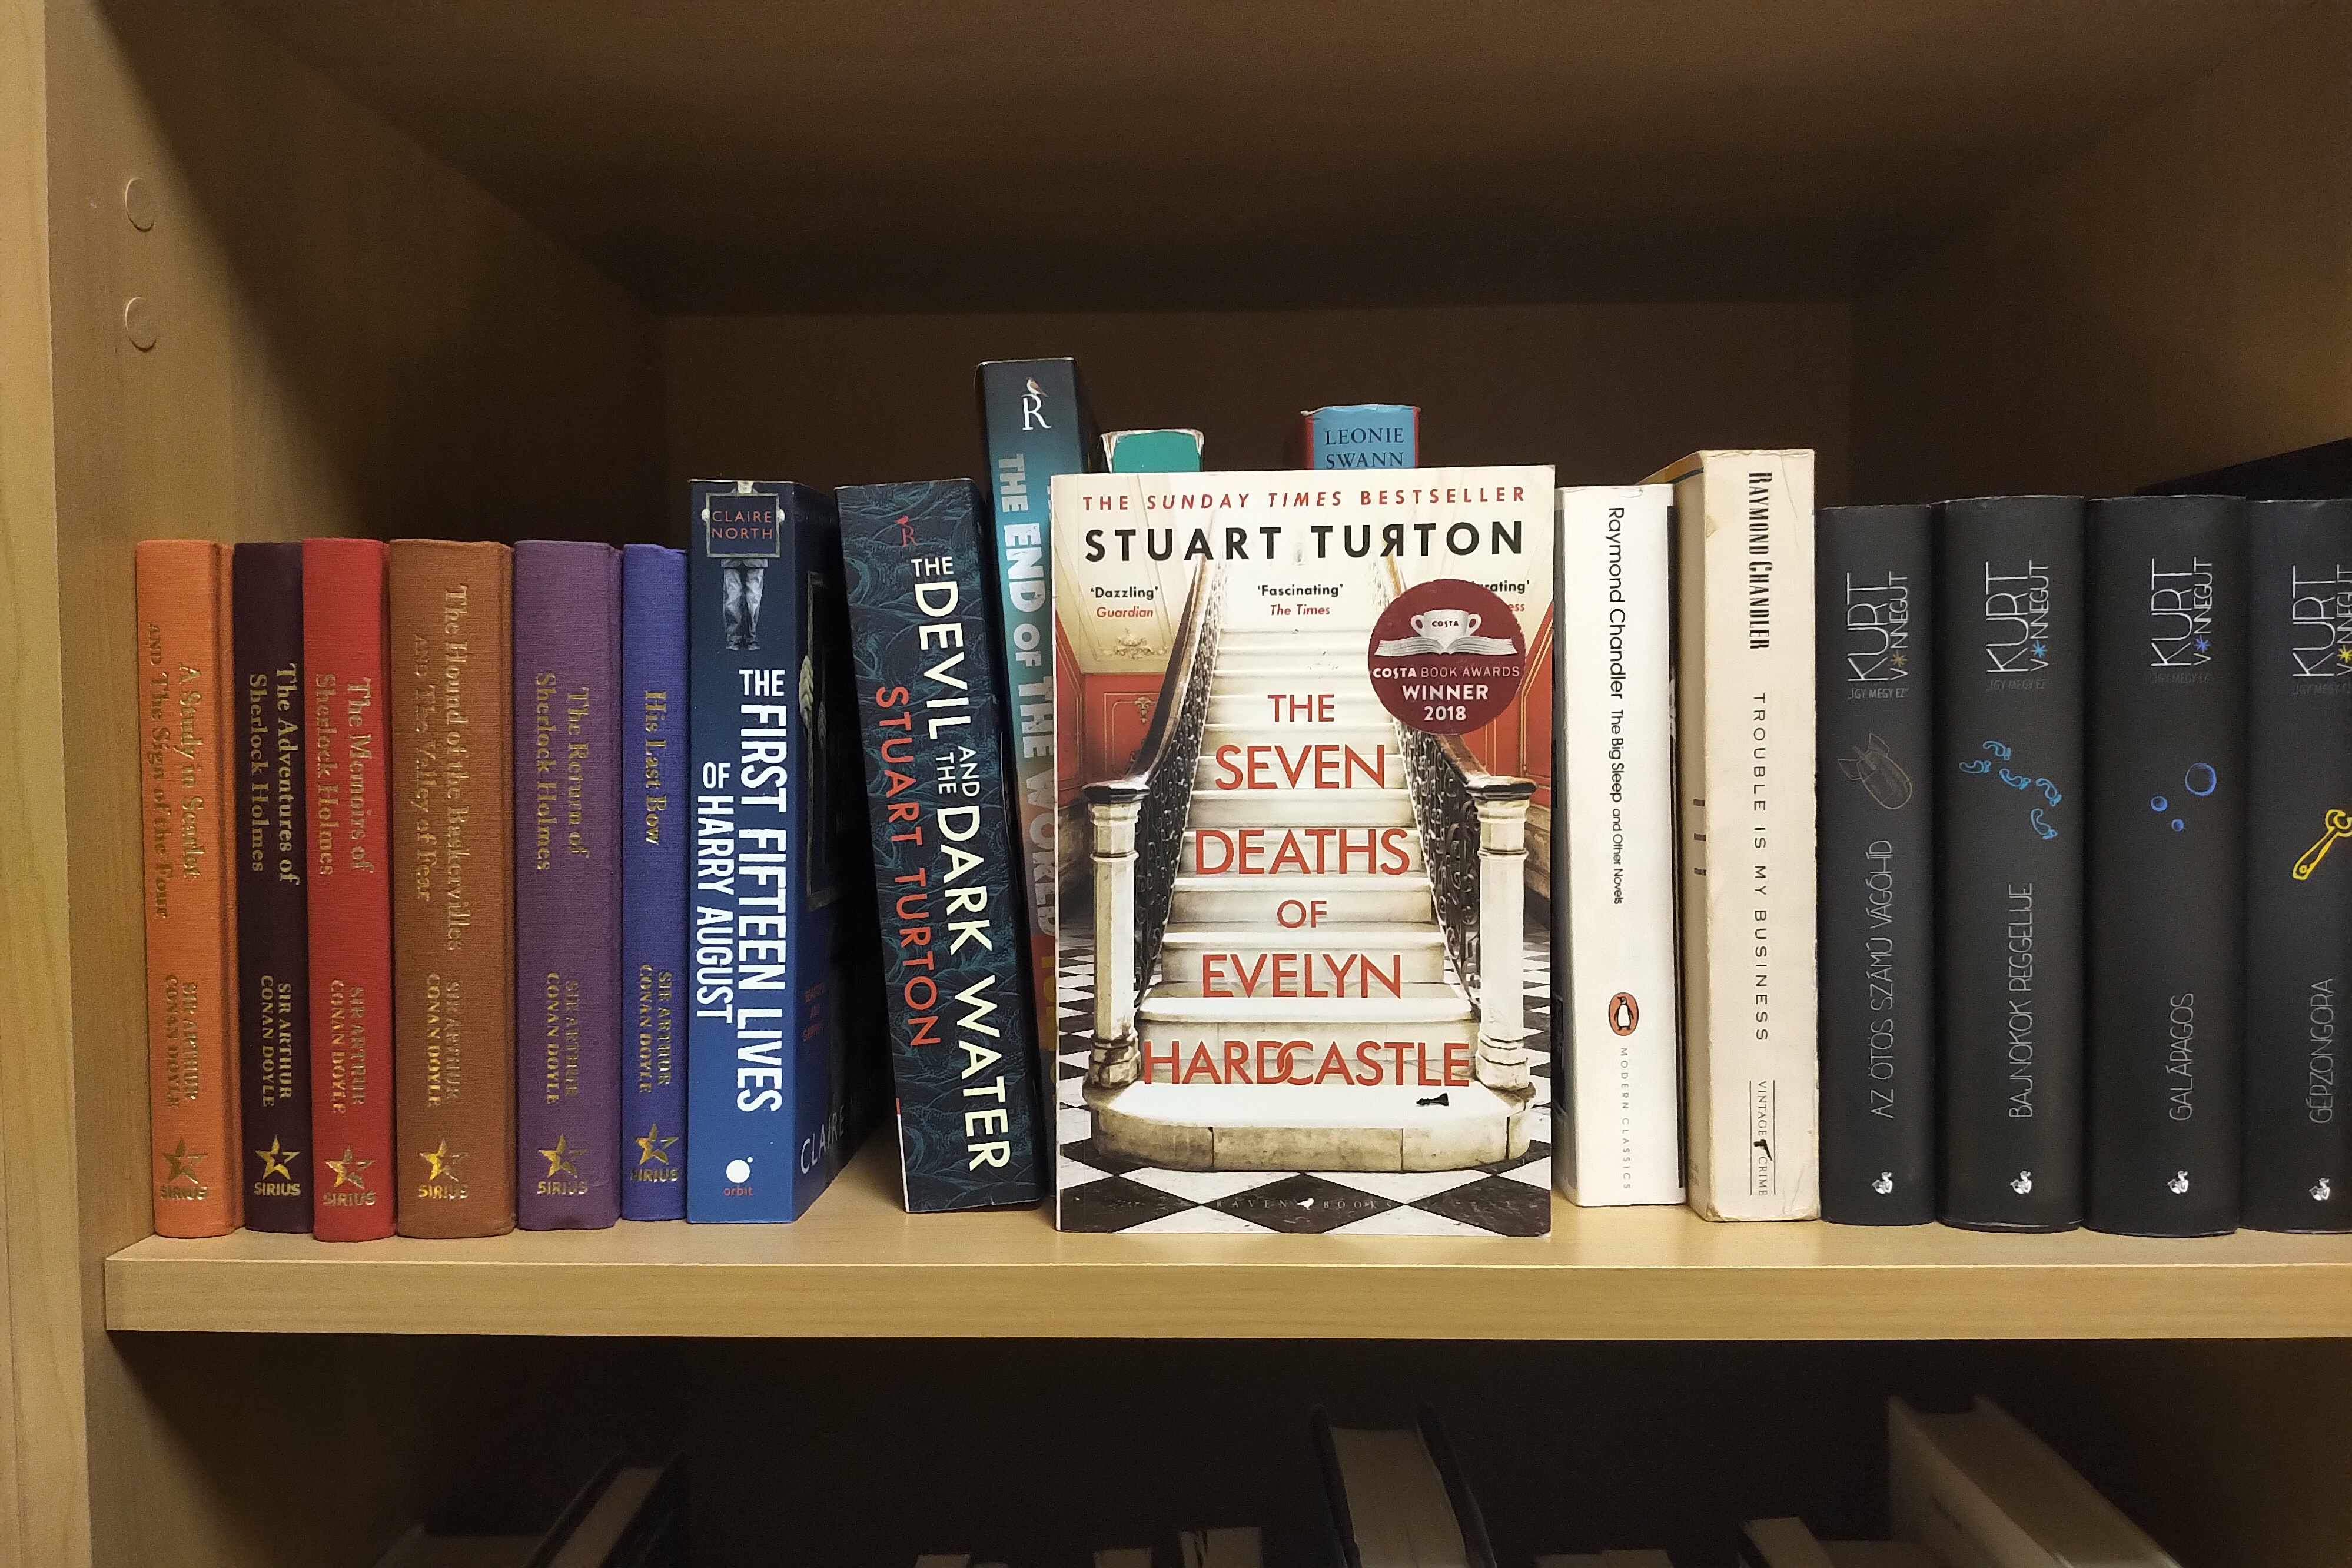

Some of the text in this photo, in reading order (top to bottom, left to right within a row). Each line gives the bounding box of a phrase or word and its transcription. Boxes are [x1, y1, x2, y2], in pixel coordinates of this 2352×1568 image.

[1325, 428, 1404, 445] LEONIE
[1325, 451, 1404, 469] SWANN
[998, 452, 1029, 513] THE
[1083, 487, 1524, 511] THE SUNDAY TIMES BESTSELLER
[712, 510, 772, 523] CLAIRE
[712, 527, 772, 539] NORTH
[911, 556, 954, 577] THE
[1004, 523, 1045, 613] END
[1085, 526, 1281, 562] STUART
[1748, 472, 1773, 650] RAYMOND CHANDLER
[444, 584, 468, 635] The
[1096, 606, 1153, 618] Guardian
[1270, 603, 1330, 617] The Times
[1847, 572, 1889, 682] KURT
[1986, 560, 2028, 673] KURT
[2151, 557, 2192, 667] KURT
[2293, 565, 2334, 677] KURT
[148, 623, 161, 666] AND
[414, 634, 429, 677] AND
[915, 582, 971, 740] DEVIL
[1012, 623, 1041, 666] OF
[150, 671, 170, 720] The
[178, 662, 202, 684] A
[444, 640, 469, 725] Hound
[739, 669, 785, 696] THE
[1373, 666, 1520, 679] COSTA BOOK AWARDS
[1403, 684, 1489, 700] WINNER
[415, 684, 437, 734] The
[1018, 676, 1054, 758] THE
[1268, 694, 1334, 723] THE
[1424, 706, 1466, 722] 2018
[1605, 506, 1626, 905] Raymond Chandler The Big Sleep and Other Novels
[148, 726, 171, 780] Sign
[249, 673, 270, 872] Sherlock Holmes
[446, 734, 471, 759] of
[535, 672, 557, 871] Sherlock Holmes
[645, 690, 668, 846] His Last Bow
[957, 746, 981, 797] AND
[1215, 744, 1384, 790] SEVEN
[277, 663, 300, 885] The Adventures of
[315, 673, 340, 876] Sherlock Holmes
[347, 677, 374, 873] The Memoirs of
[446, 756, 469, 801] the
[567, 687, 590, 859] The Return of
[703, 762, 730, 788] OF
[935, 752, 958, 795] THE
[875, 687, 941, 1046] STUART TURTON
[1025, 770, 1058, 937] WORLD
[1196, 829, 1410, 876] DEATHS
[1752, 692, 1769, 1041] TROUBLE IS MY BUSINESS
[696, 796, 735, 1024] HARRY AUGUST
[737, 705, 788, 1112] FIRST FIFTEEN LIVES
[1277, 899, 1327, 928] OF
[564, 980, 579, 1010] SIR
[936, 804, 1011, 1171] DARK WATER
[1202, 954, 1402, 999] EVELYN
[1866, 839, 1895, 1119] AZ ÖTÖS SZÁMÚ VÁGÓHÍD
[261, 975, 274, 1108] CONAN DOYLE
[278, 982, 293, 1099] SIR ARTHUR
[330, 978, 346, 1114] CONAN DOYLE
[350, 985, 367, 1105] SIR ARTHUR
[427, 974, 441, 1108] CONAN DOYLE
[546, 972, 560, 1105] CONAN DOYLE
[639, 964, 653, 1094] CONAN DOYLE
[657, 970, 672, 1086] SIR ARTHUR
[2305, 977, 2334, 1124] GÉPZONGORA
[1144, 1041, 1470, 1087] HARDCASTLE
[2009, 999, 2034, 1119] BAJNOKOK
[2165, 992, 2194, 1122] GALÁPAGOS
[800, 1104, 844, 1174] CLAIRE
[1620, 1047, 1631, 1190] MODERN CLASSICS
[1757, 1081, 1769, 1196] VINTAGE CRIME
[160, 1186, 208, 1201] SIRIUS
[254, 1182, 301, 1197] SIRIUS
[323, 1190, 376, 1207] SIRIUS
[418, 1184, 469, 1200] SIRIUS
[537, 1181, 589, 1195] SIRIUS
[630, 1167, 679, 1183] SIRIUS
[723, 1187, 753, 1196] orbit
[1323, 1201, 1392, 1209] BOOKS
